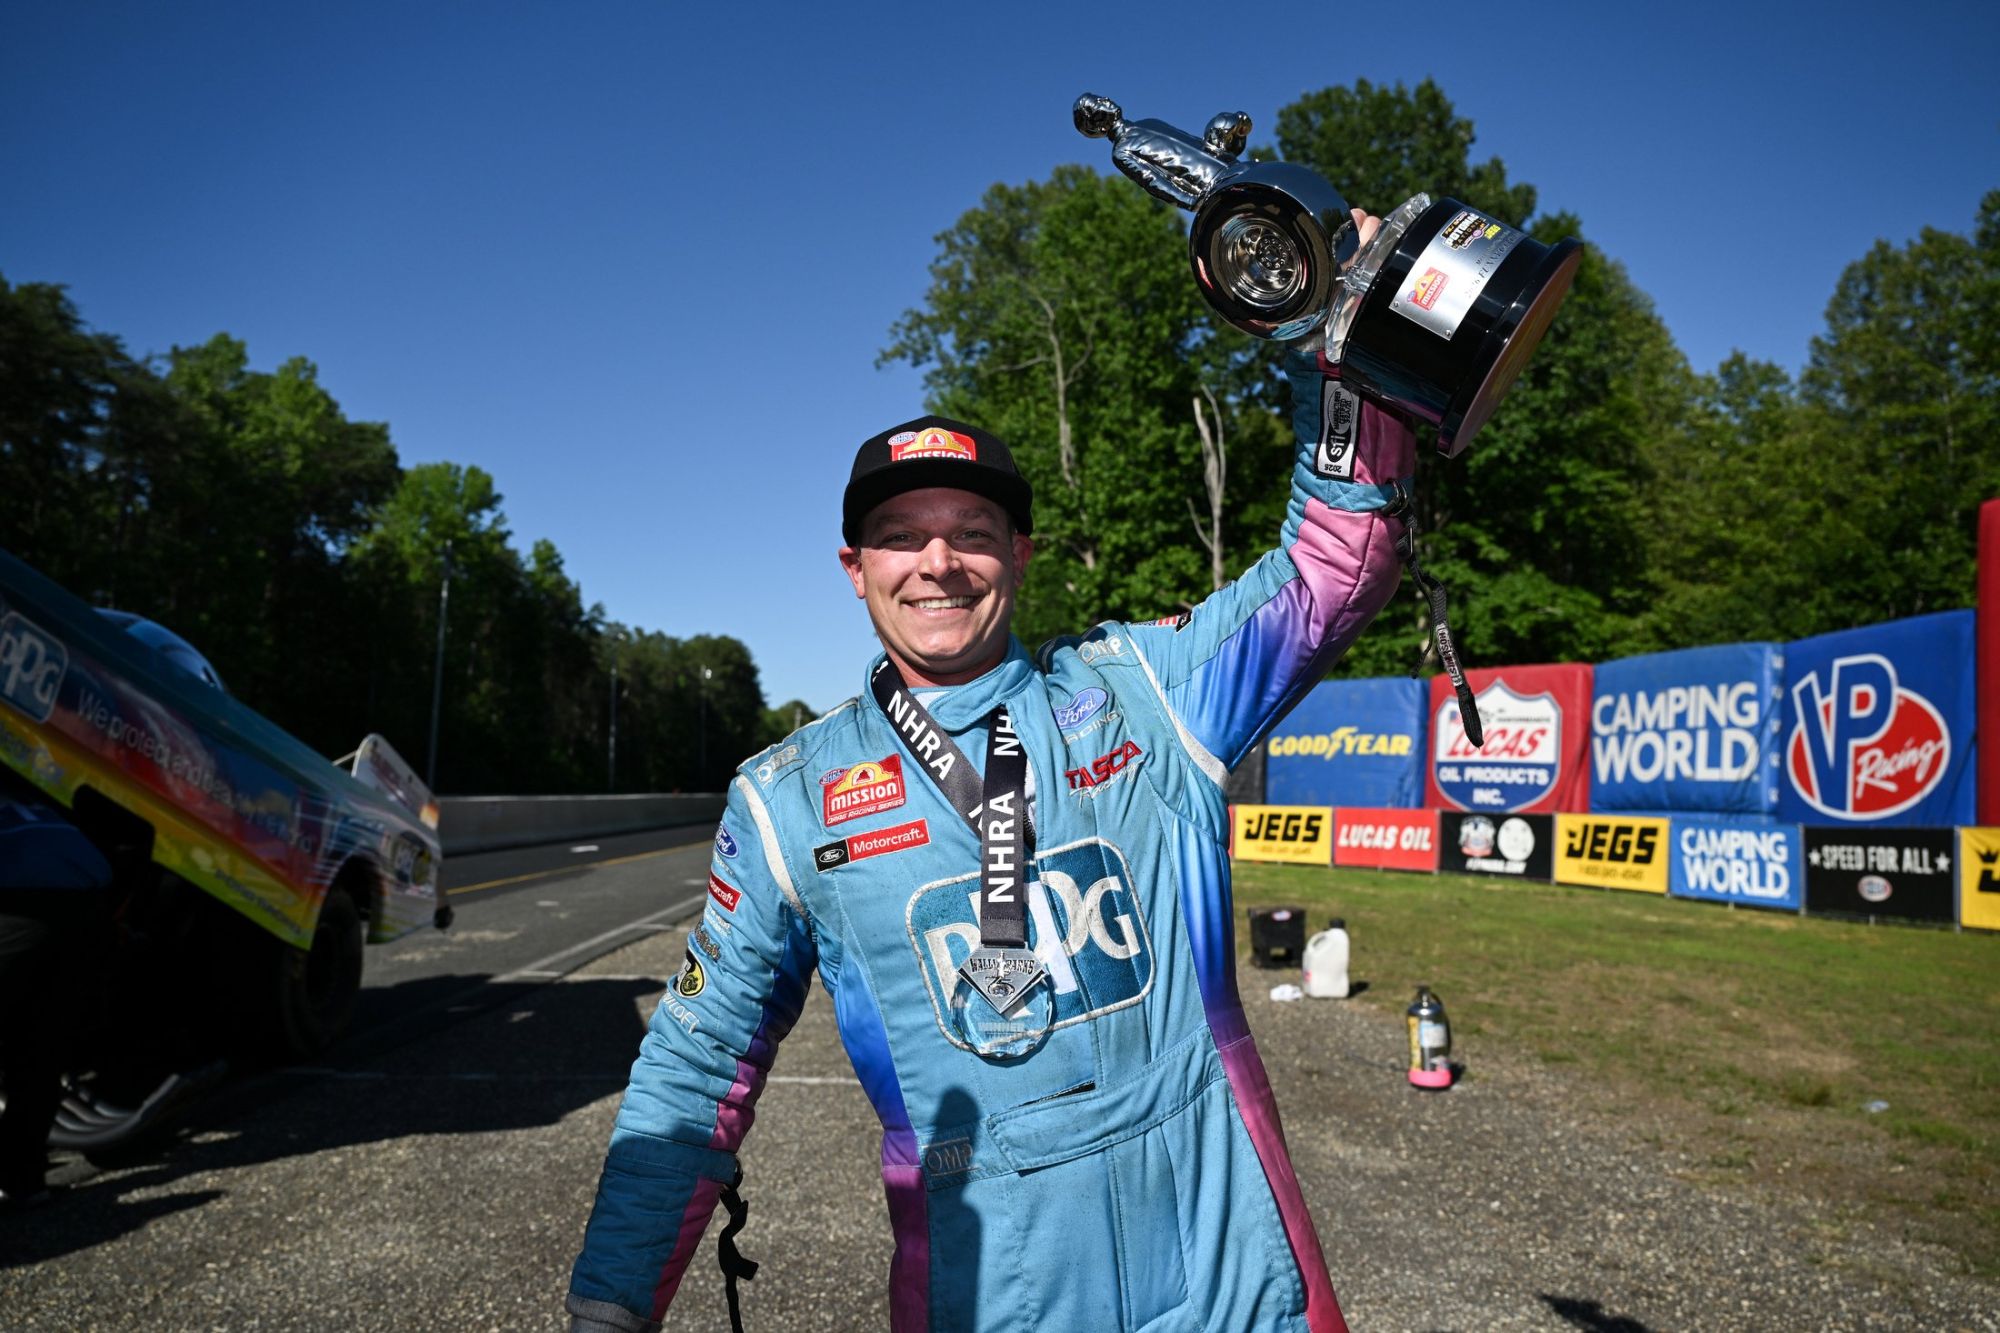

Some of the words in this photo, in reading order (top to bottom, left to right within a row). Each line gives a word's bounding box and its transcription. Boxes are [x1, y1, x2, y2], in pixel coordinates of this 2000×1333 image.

[1058, 695, 1097, 726] Ford
[1592, 682, 1760, 736] CAMPING
[887, 690, 956, 781] NHRA
[1447, 728, 1548, 757] LUCAS
[1792, 653, 1899, 816] VP
[1065, 740, 1143, 789] TASCA
[1464, 767, 1550, 786] PRODUCTS
[1592, 729, 1759, 784] WORLD
[1855, 737, 1940, 799] Racing
[848, 806, 876, 819] RACING
[877, 798, 906, 811] SERIES
[1245, 814, 1323, 843] JEGS
[988, 790, 1015, 903] NHRA
[1338, 824, 1396, 849] LUCAS
[1401, 825, 1433, 851] OIL
[1566, 824, 1658, 864] JEGS
[1680, 827, 1789, 863] CAMPING
[1682, 855, 1790, 898] WORLD
[1821, 844, 1865, 871] SPEED
[1867, 846, 1899, 872] FOR
[1902, 847, 1934, 875] ALL
